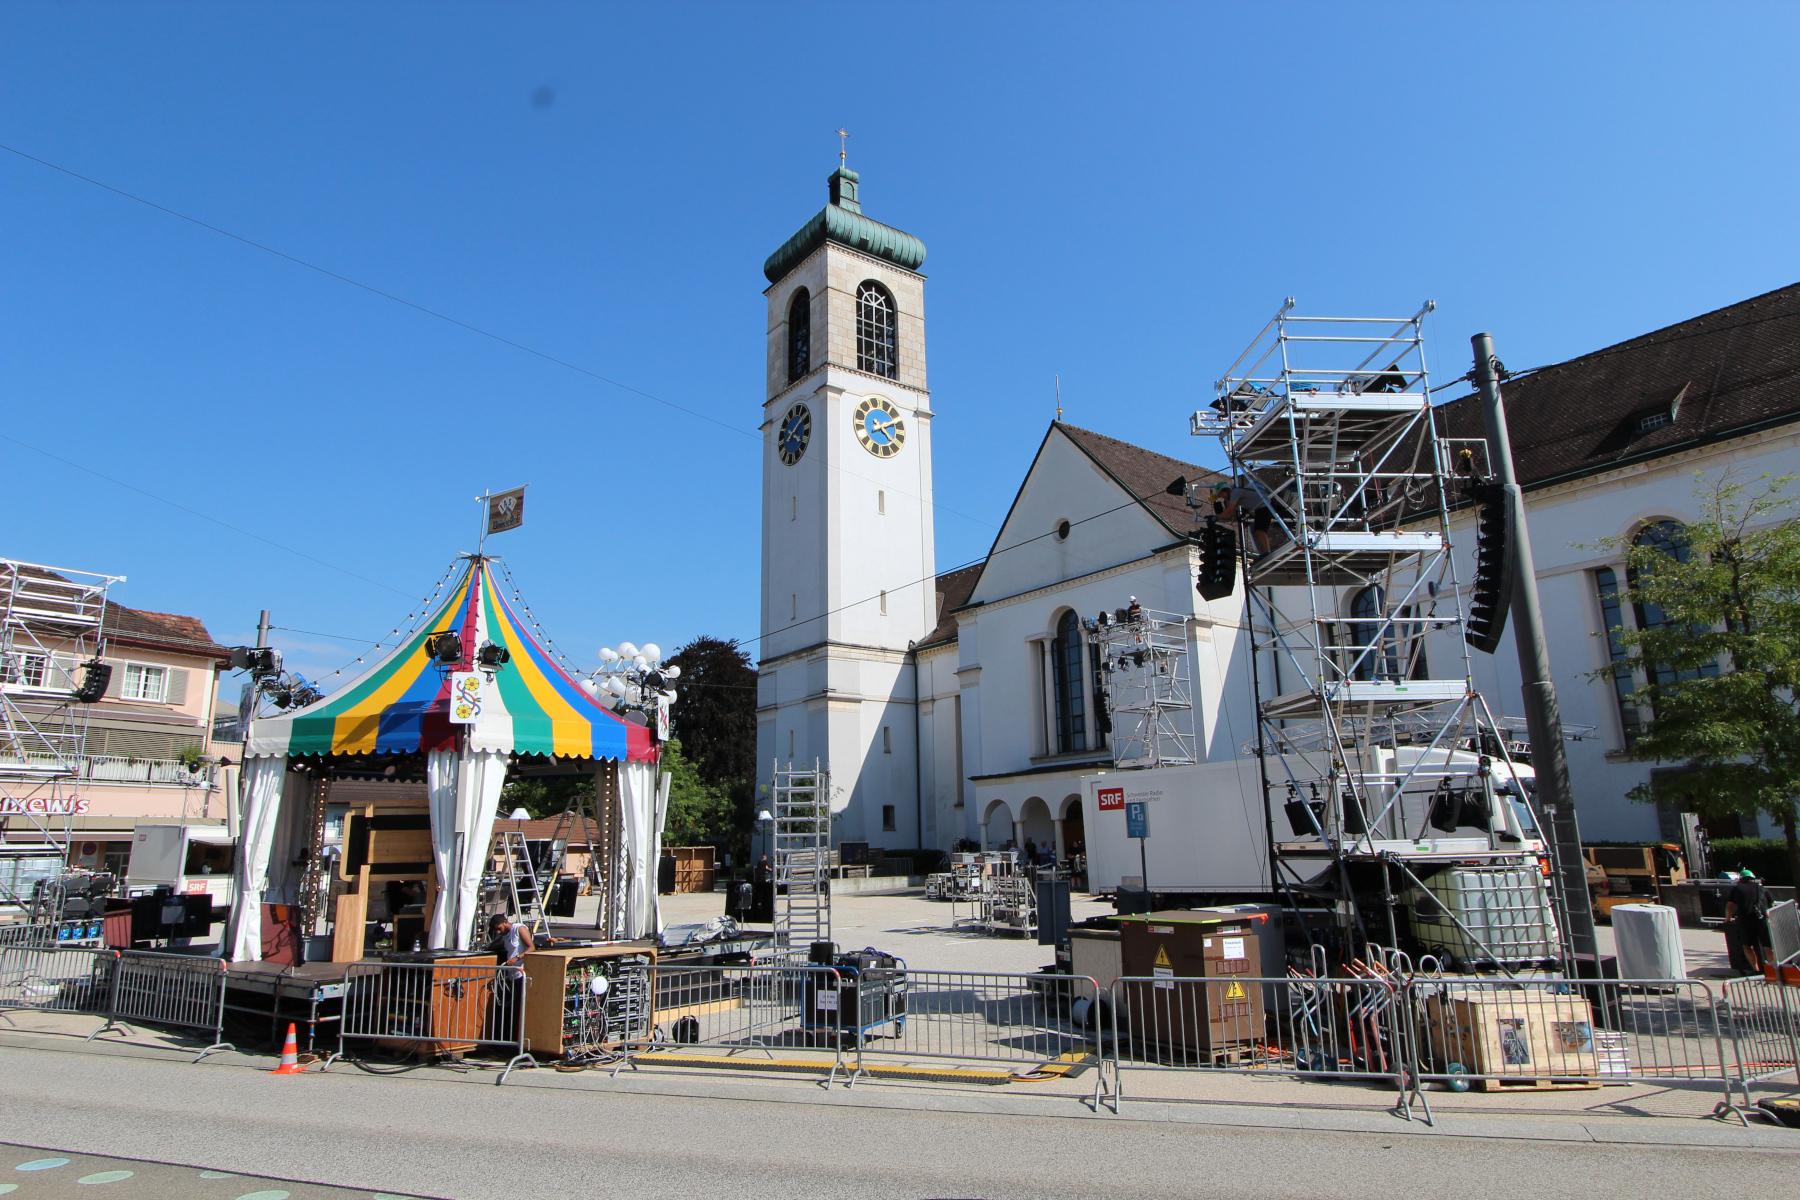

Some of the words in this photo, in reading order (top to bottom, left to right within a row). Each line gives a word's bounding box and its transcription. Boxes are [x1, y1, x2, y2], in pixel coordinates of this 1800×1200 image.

[1100, 793, 1122, 806] SRF
[1131, 804, 1140, 819] P
[189, 883, 206, 891] SRF
